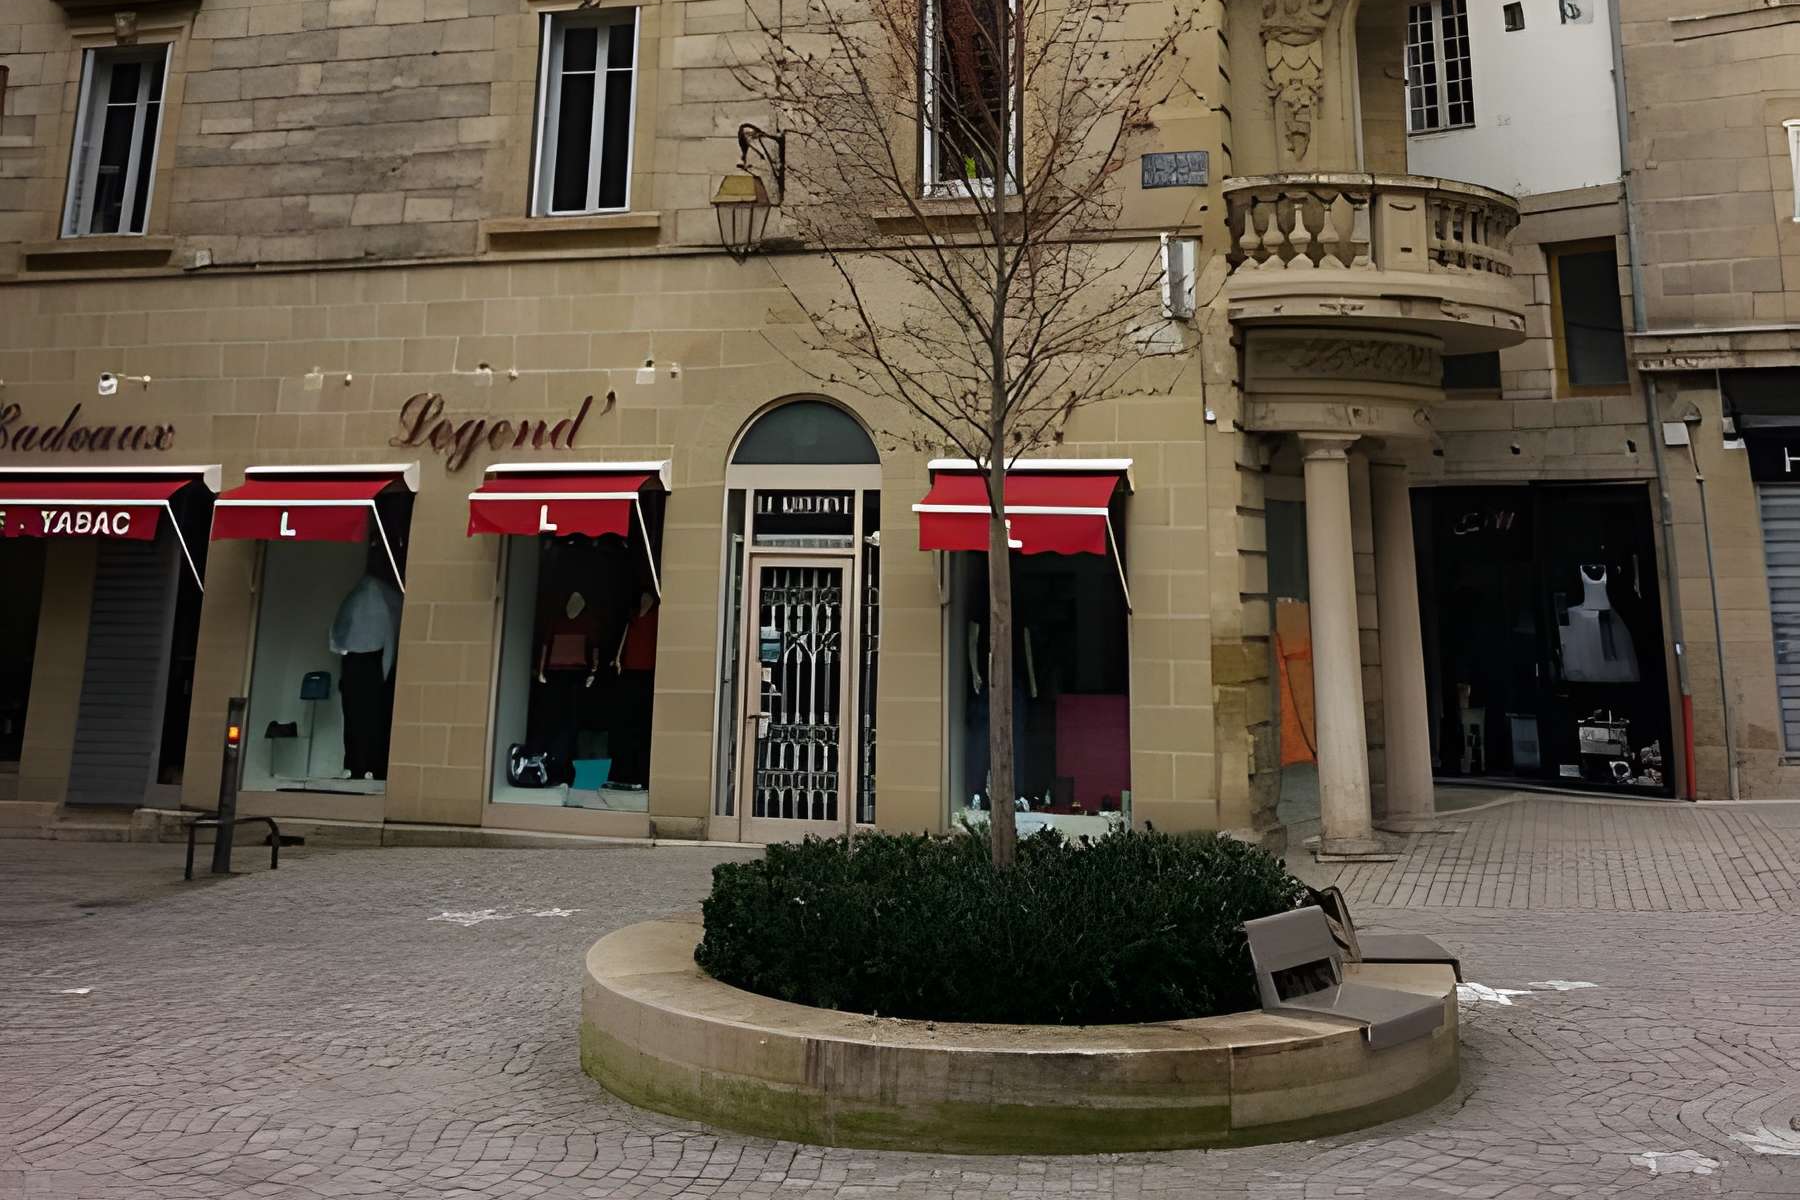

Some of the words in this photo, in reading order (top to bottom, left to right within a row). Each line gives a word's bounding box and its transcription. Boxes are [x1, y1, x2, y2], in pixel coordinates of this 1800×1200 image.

[40, 510, 131, 535] TABAC
[280, 511, 297, 537] L
[539, 504, 558, 532] L
